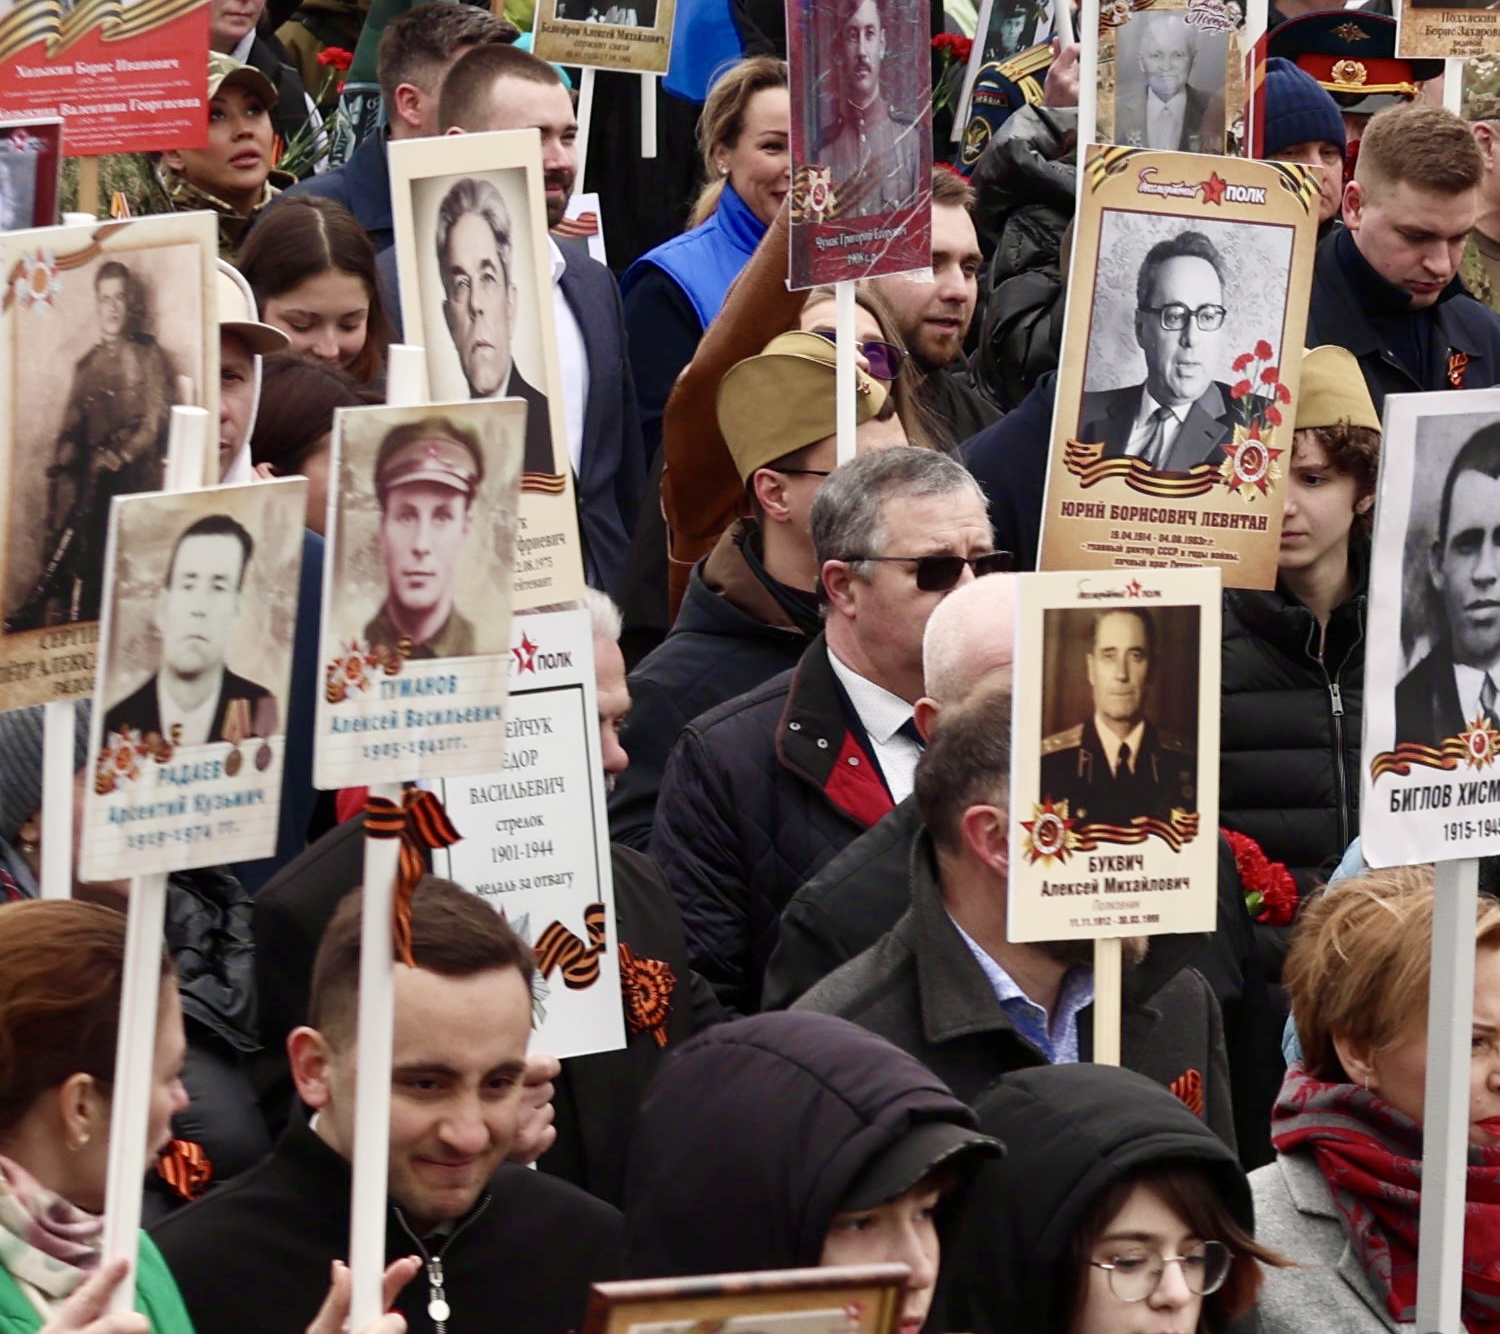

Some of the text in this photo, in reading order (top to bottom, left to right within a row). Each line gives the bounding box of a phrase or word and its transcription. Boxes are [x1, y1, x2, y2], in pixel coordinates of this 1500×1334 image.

[1224, 184, 1267, 205] ПОЛК
[1060, 500, 1269, 531] ЮРИЙ БОРИСОВИЧ ЛЕВИТАН
[537, 651, 573, 670] ПОЛК
[380, 674, 460, 701] ТУМАНОВ
[331, 710, 400, 734] Алексей
[503, 749, 539, 769] ЕДОР
[469, 775, 566, 805] ВАСИЛЬЕВИЧ
[1389, 784, 1452, 813] БИГЛОВ
[494, 814, 545, 835] стрелок
[490, 840, 555, 864] 1901-1944
[1088, 854, 1144, 873] БУКВИЧ
[1039, 874, 1190, 898] Алексей Михайлович
